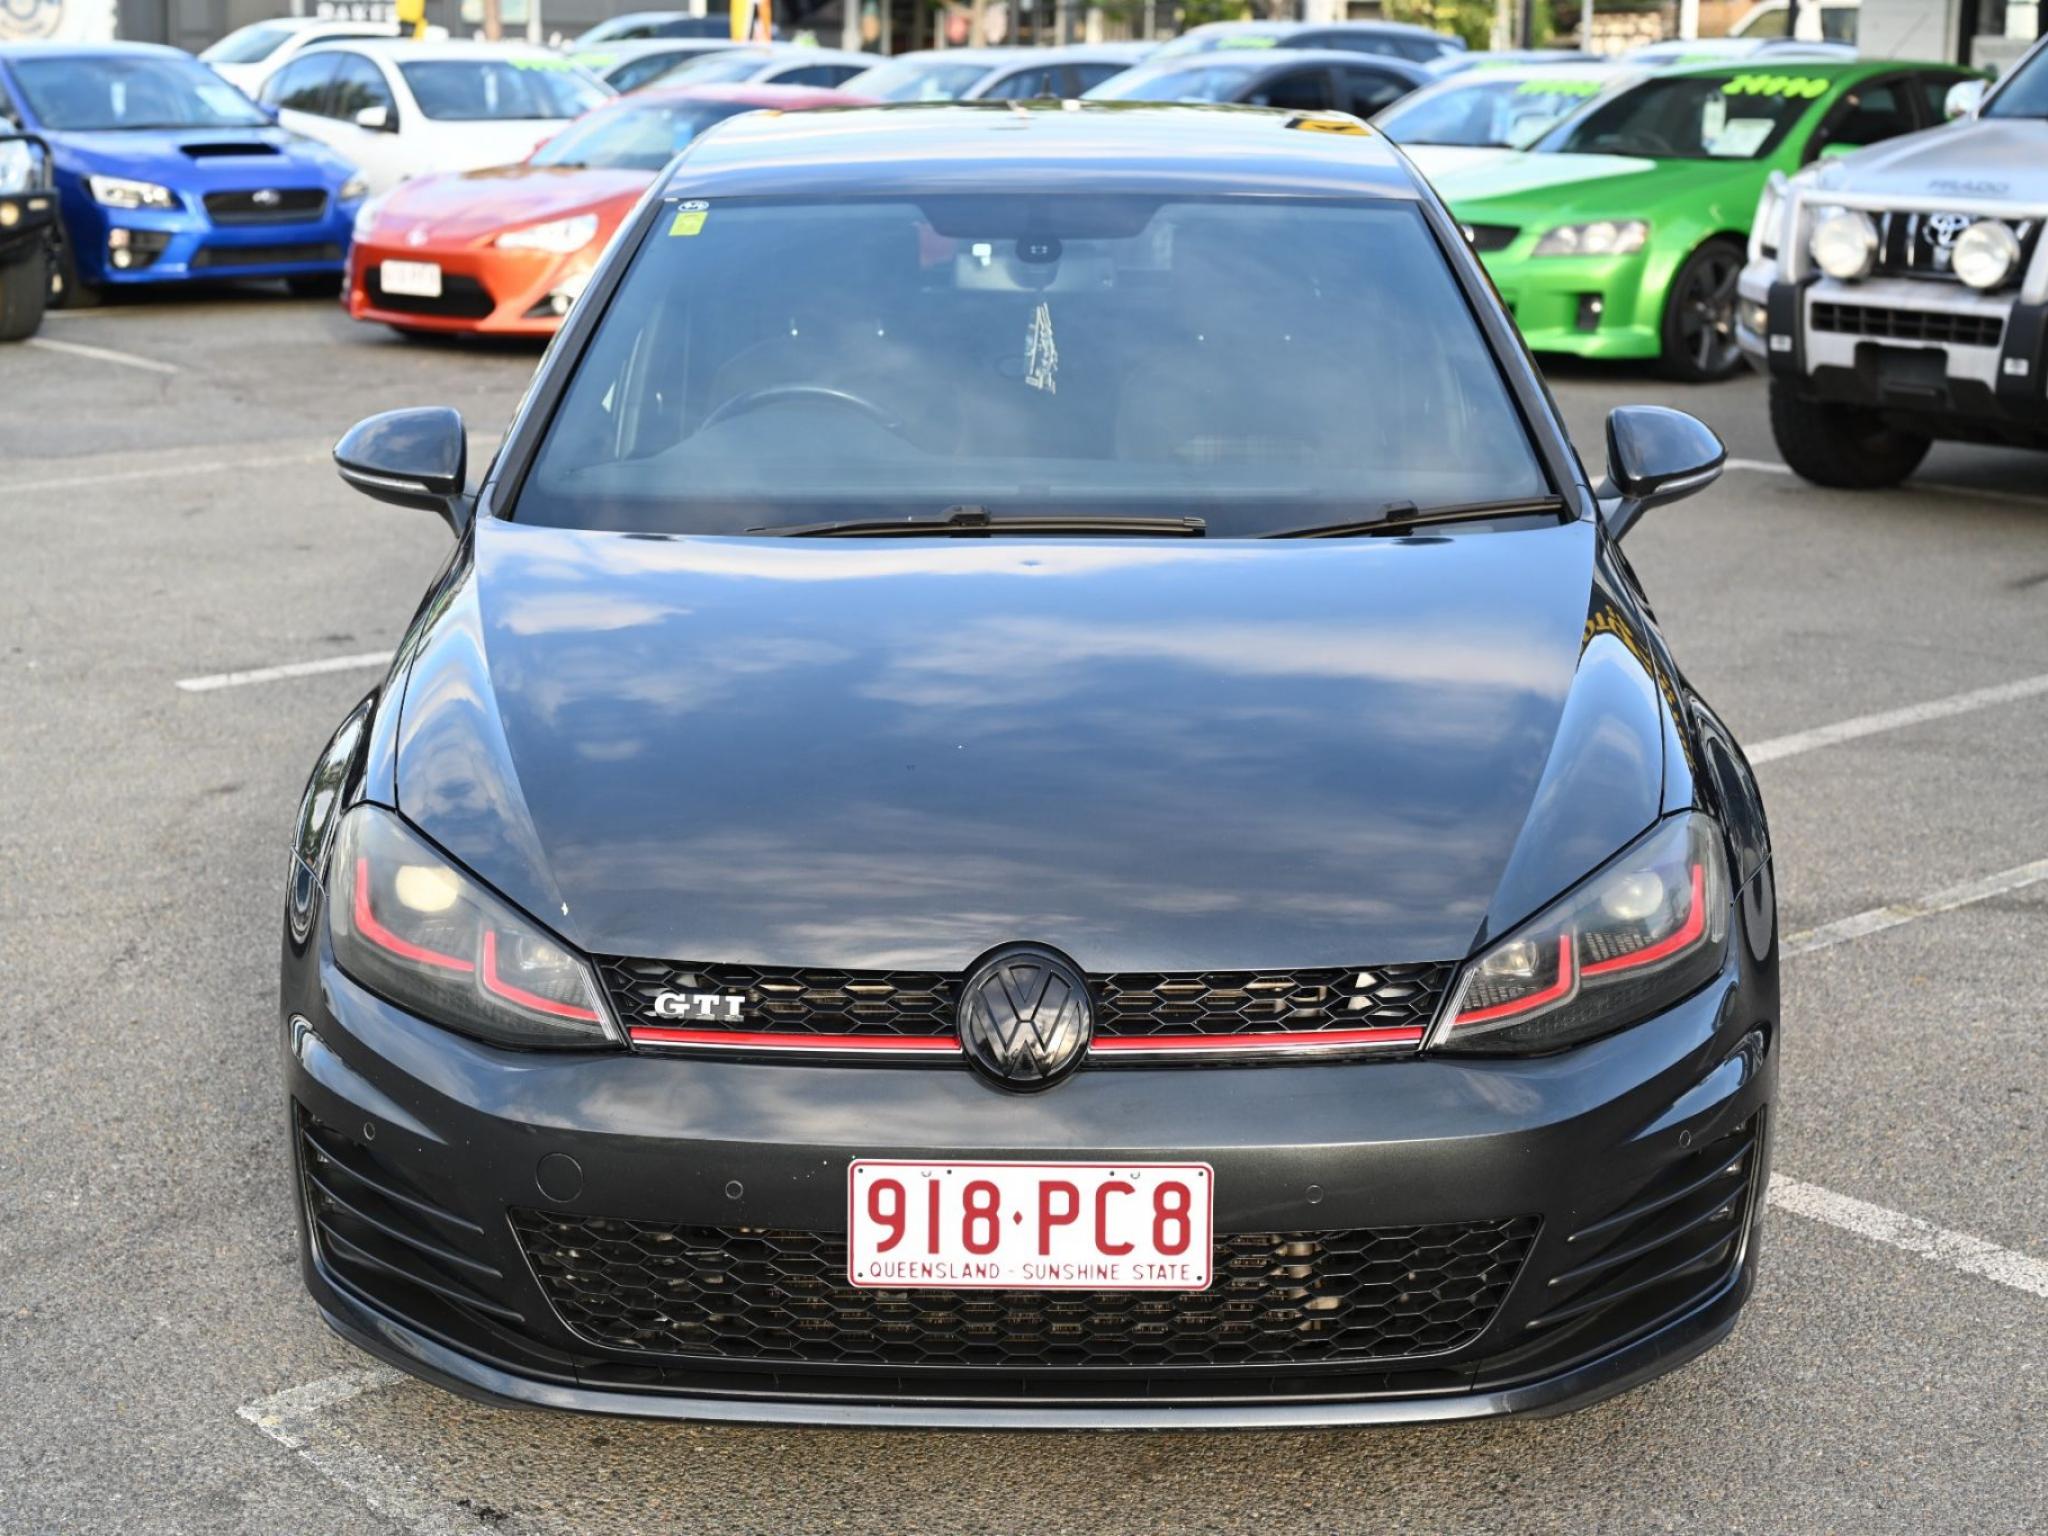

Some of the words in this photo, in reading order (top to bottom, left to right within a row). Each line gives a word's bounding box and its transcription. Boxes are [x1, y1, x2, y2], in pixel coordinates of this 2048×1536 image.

[654, 992, 746, 1022] GTI
[870, 1261, 1000, 1279] QUEENSLAND
[1022, 1263, 1120, 1281] SUNSHINE
[1132, 1263, 1190, 1281] STATE
